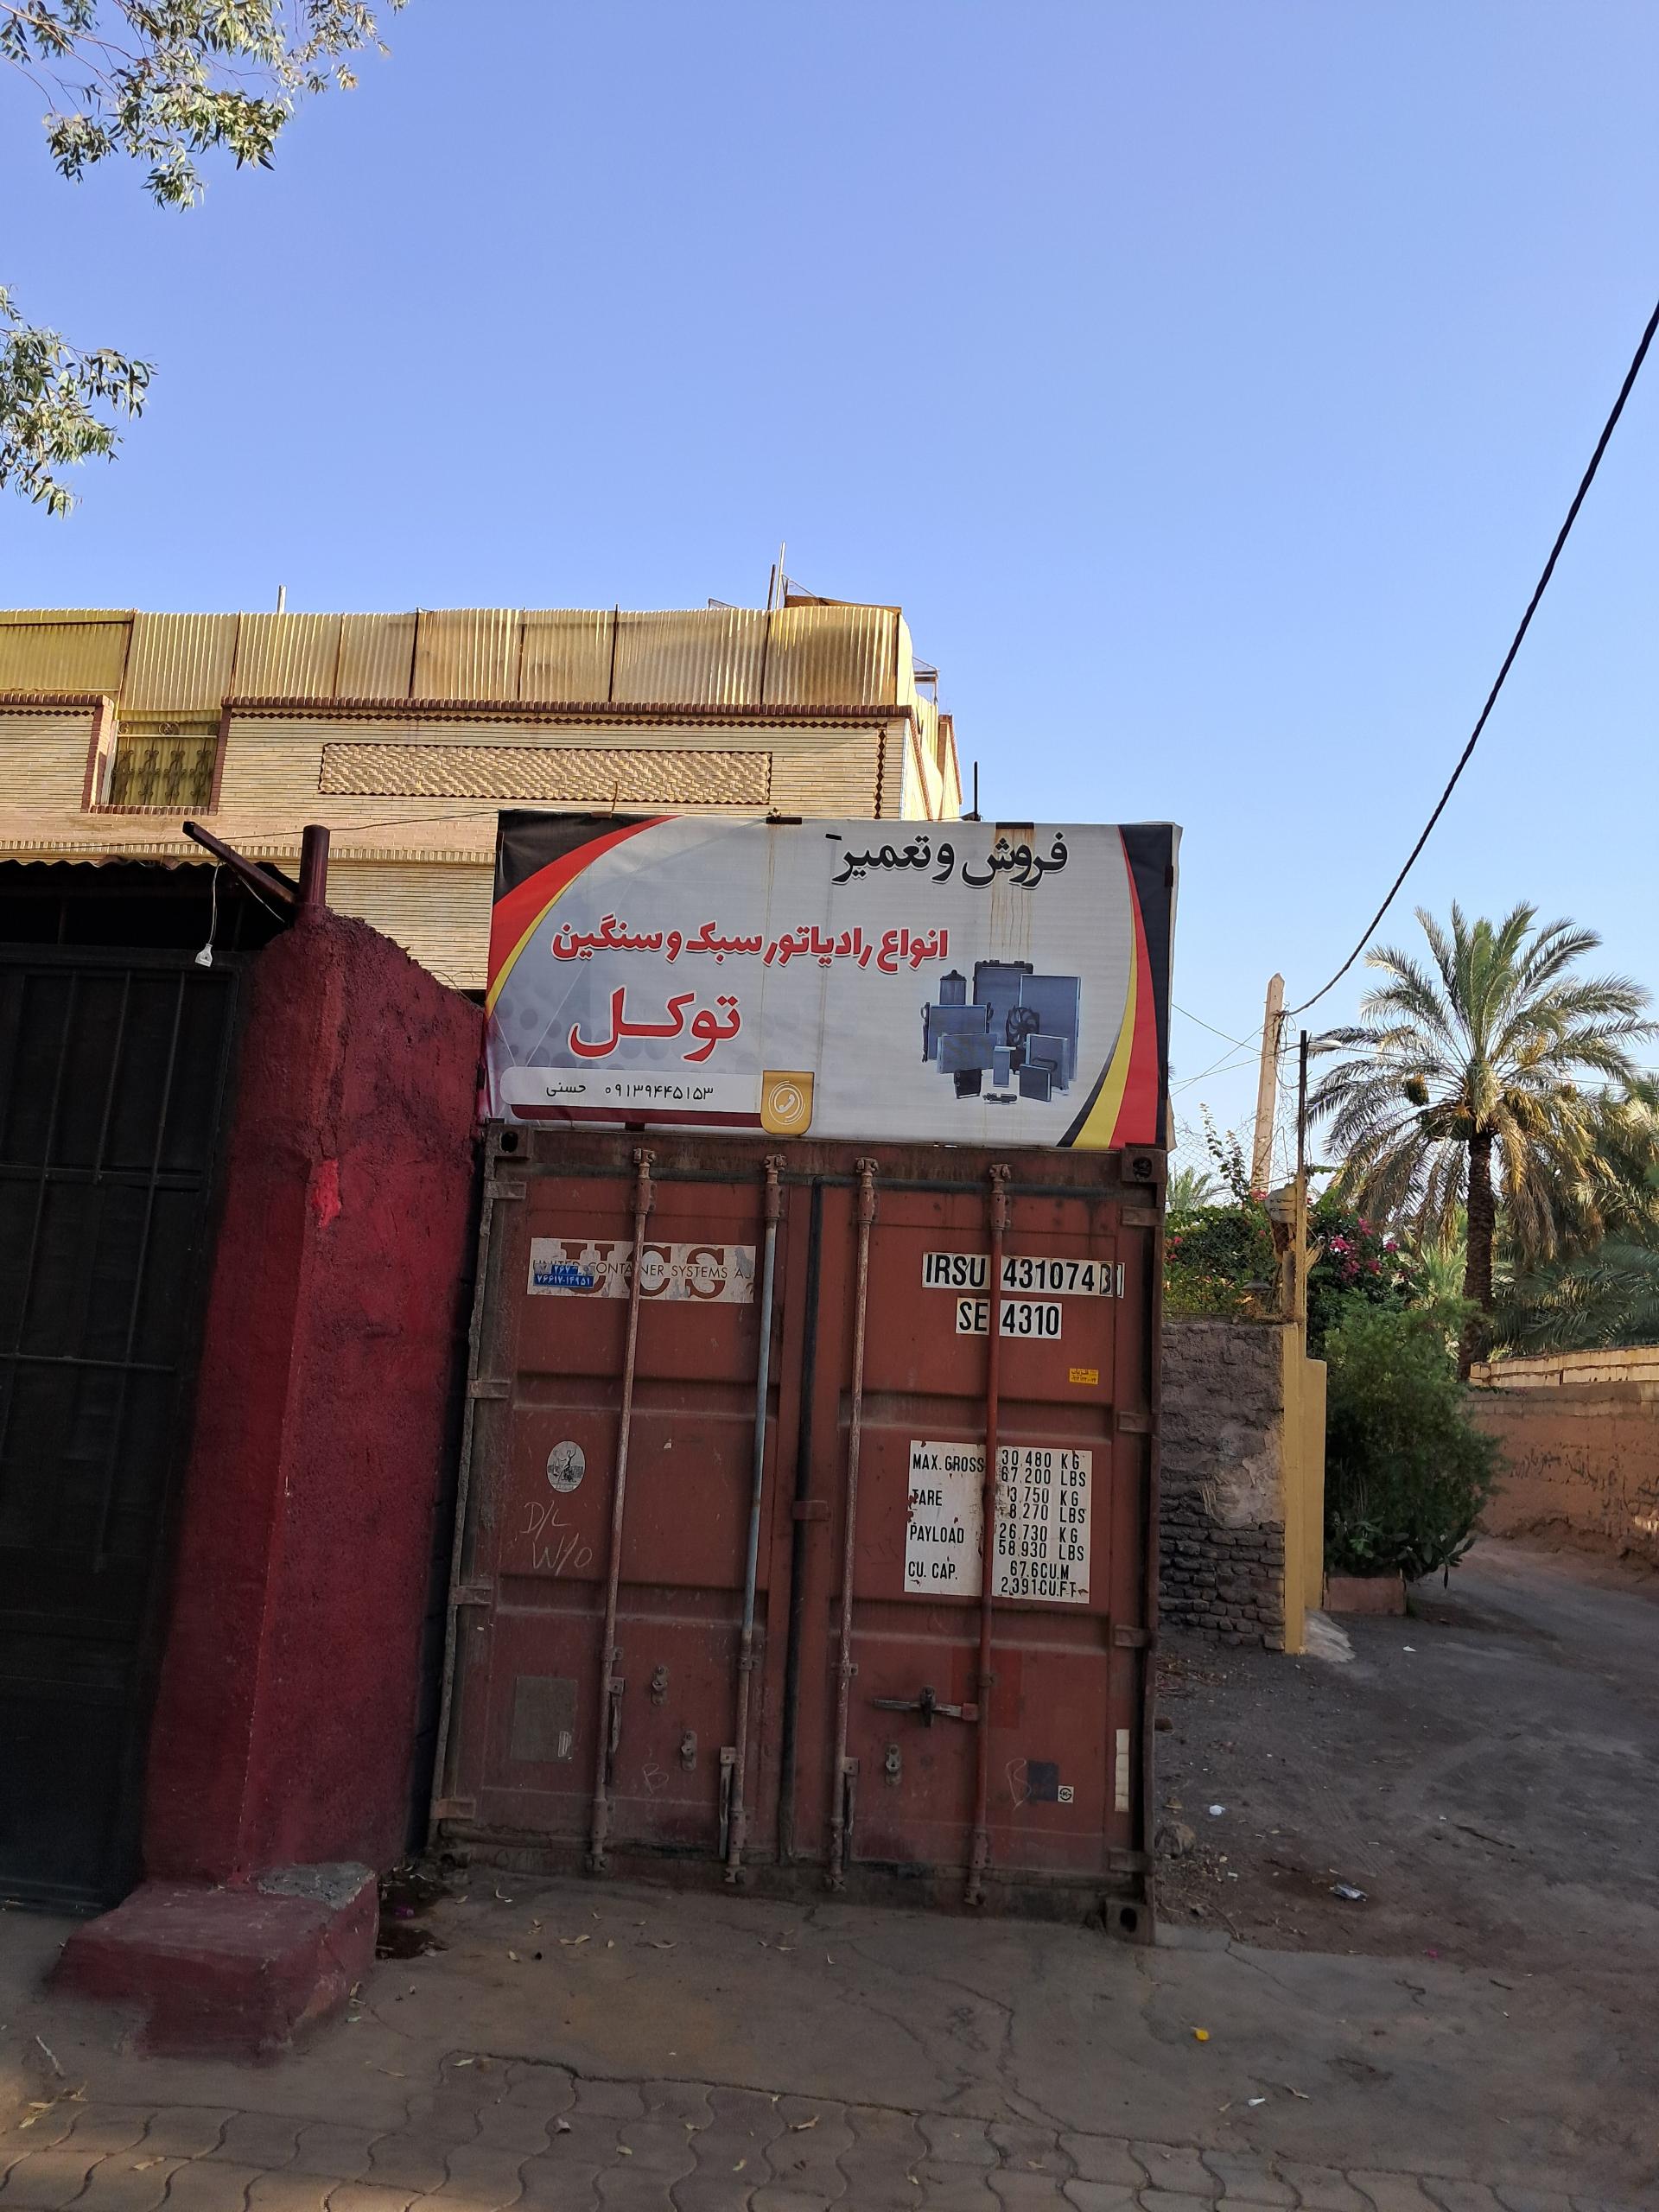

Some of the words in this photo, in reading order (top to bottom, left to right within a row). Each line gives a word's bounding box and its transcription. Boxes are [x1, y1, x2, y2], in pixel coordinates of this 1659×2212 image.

[831, 835, 932, 884] تعمیر
[962, 832, 1068, 888] فروش
[551, 912, 664, 961] سنگین
[684, 920, 762, 964] سبک
[763, 925, 873, 968] رادیاتور
[876, 927, 949, 973] انواع
[568, 985, 741, 1062] توکل
[546, 1082, 587, 1096] حسنی
[671, 1265, 728, 1281] SYSTEMS
[734, 1268, 752, 1279] A
[925, 1254, 986, 1287] IRSU
[959, 1301, 988, 1332] SE
[1001, 1303, 1059, 1335] 4310
[912, 1453, 942, 1471] MAX.
[944, 1455, 985, 1472] GROSS
[1061, 1471, 1086, 1487] LBS
[912, 1489, 943, 1506] TARE
[1059, 1507, 1085, 1523] LBS
[910, 1524, 964, 1543] PAYLOAD
[1059, 1544, 1084, 1560] LBS
[908, 1561, 926, 1578] CU.
[931, 1563, 958, 1580] CAP.
